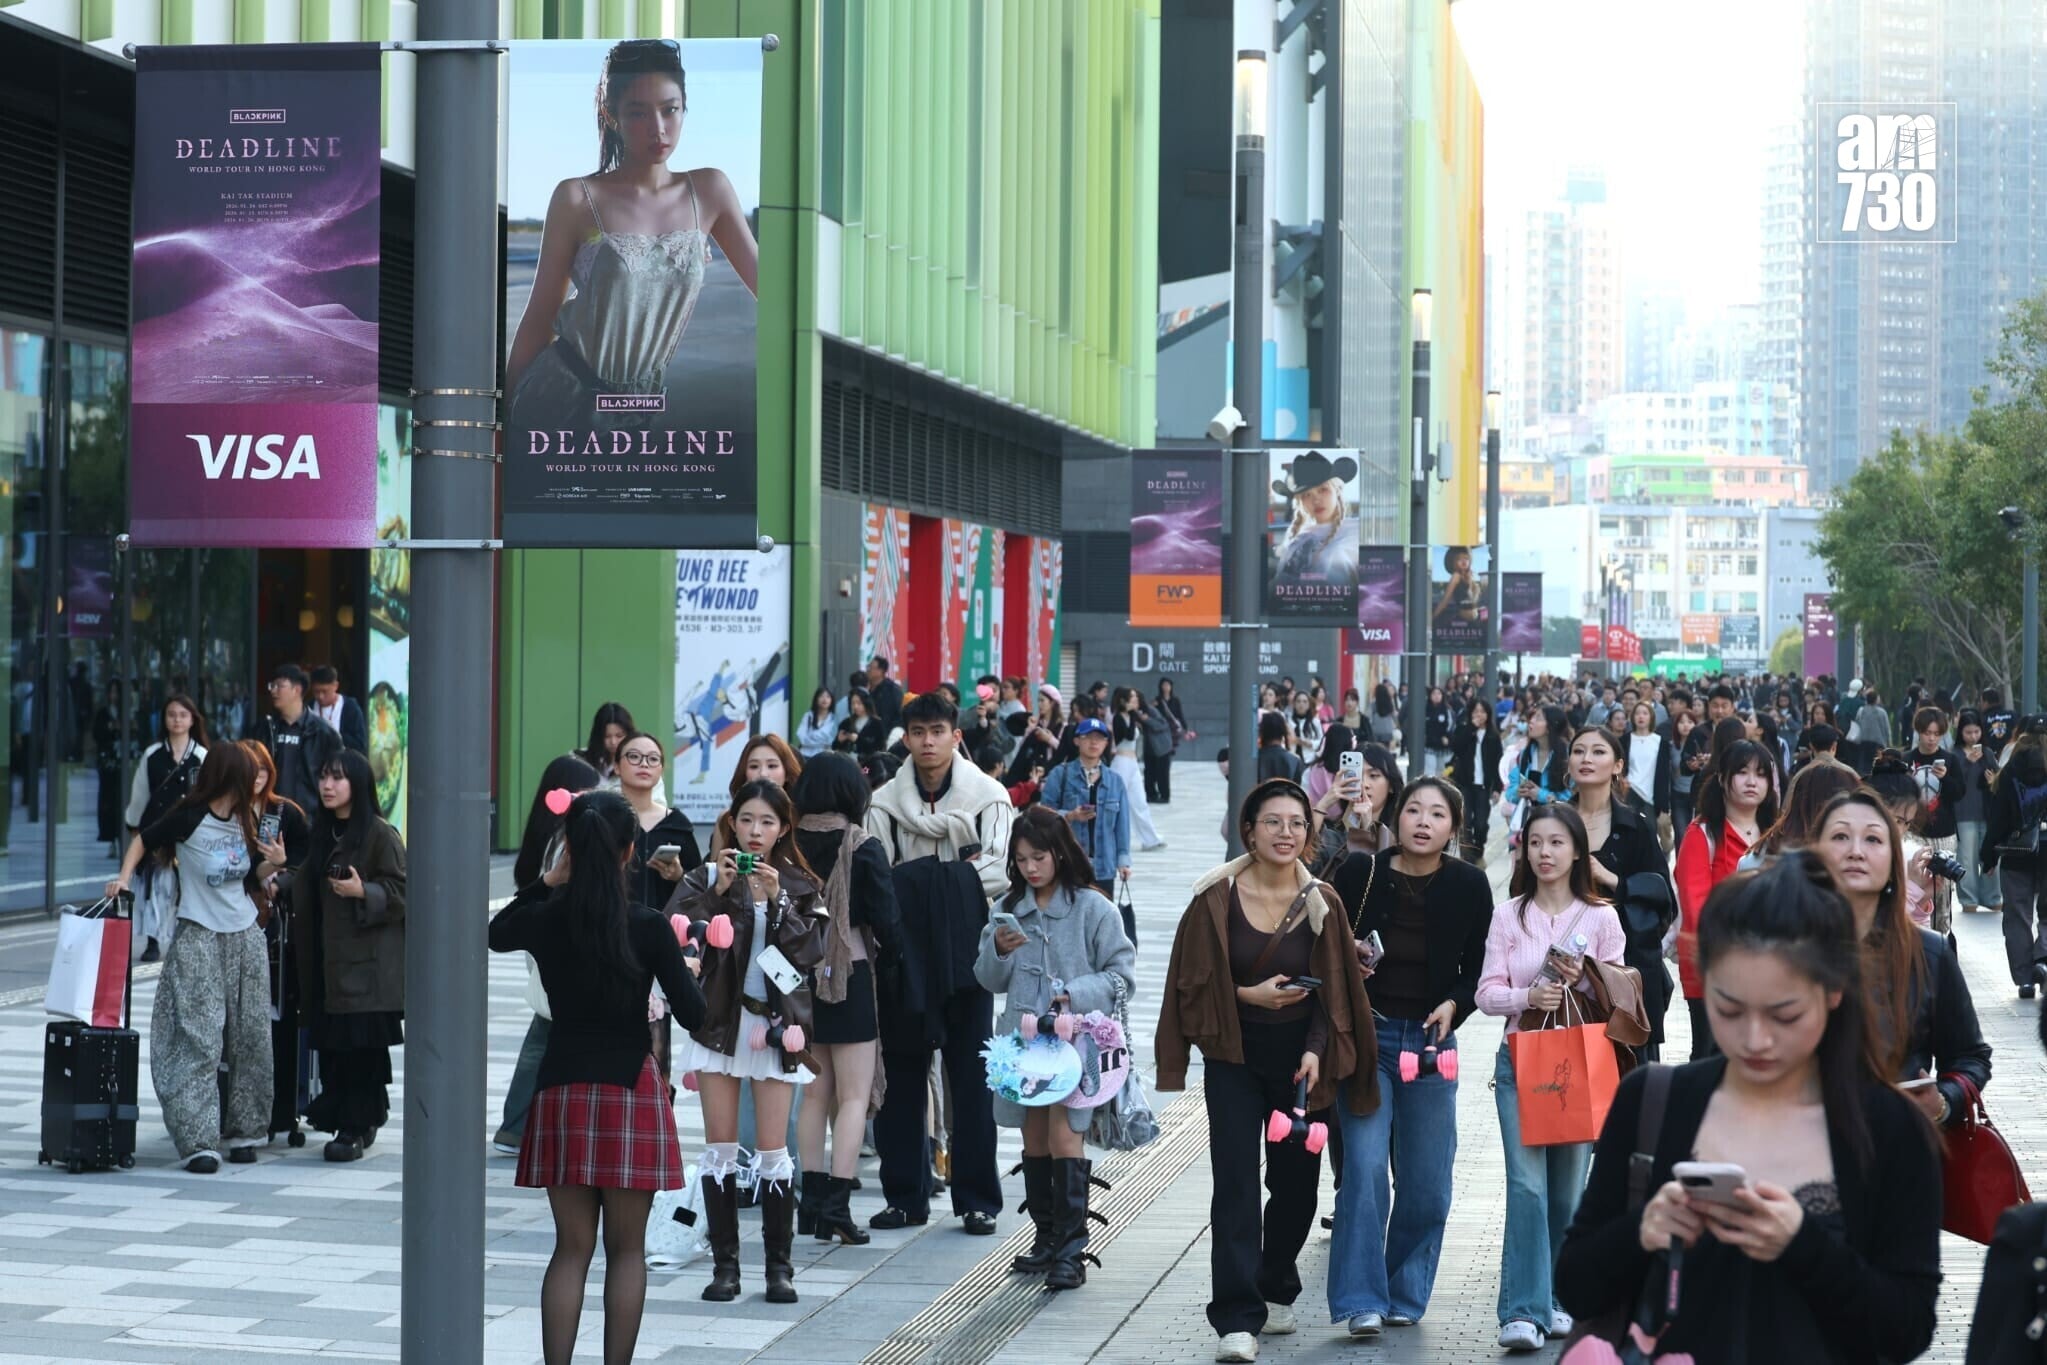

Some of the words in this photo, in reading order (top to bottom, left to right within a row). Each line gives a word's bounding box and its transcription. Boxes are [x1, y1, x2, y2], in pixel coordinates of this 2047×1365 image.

[175, 137, 342, 159] DEADLINE
[527, 430, 734, 455] DEADLINE
[185, 434, 321, 480] VISA
[546, 464, 587, 472] WORLD
[590, 464, 623, 472] TOUR
[627, 464, 639, 472] IN
[644, 464, 678, 472] HONG
[683, 464, 716, 472] KONG
[676, 559, 713, 583] UNG
[716, 559, 749, 583] HEE
[1157, 584, 1194, 599] FWD
[1276, 585, 1351, 596] DEADLINE
[1360, 628, 1391, 641] VISA
[1132, 642, 1154, 672] D
[1203, 654, 1219, 663] KAI
[1159, 661, 1190, 672] GATE
